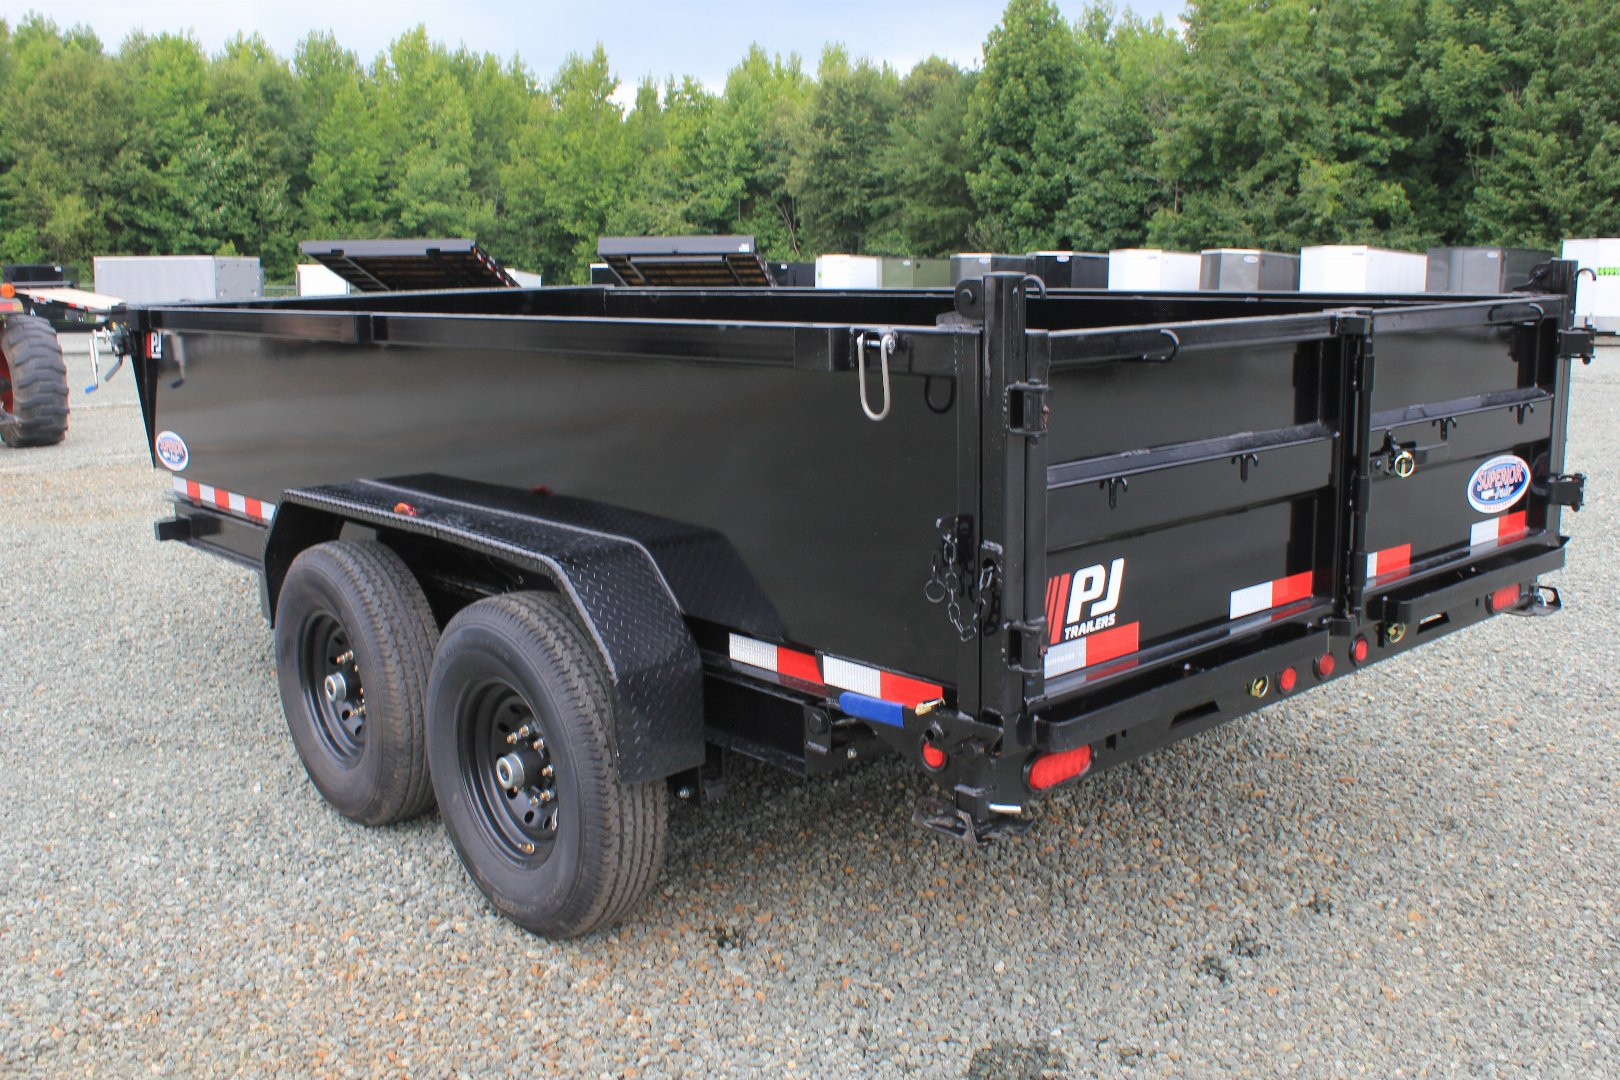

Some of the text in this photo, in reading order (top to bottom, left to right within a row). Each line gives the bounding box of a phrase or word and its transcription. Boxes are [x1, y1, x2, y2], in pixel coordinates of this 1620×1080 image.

[1476, 463, 1523, 492] SUPERIOR
[1066, 558, 1125, 625] PJ
[1064, 612, 1116, 640] TRAILERS
